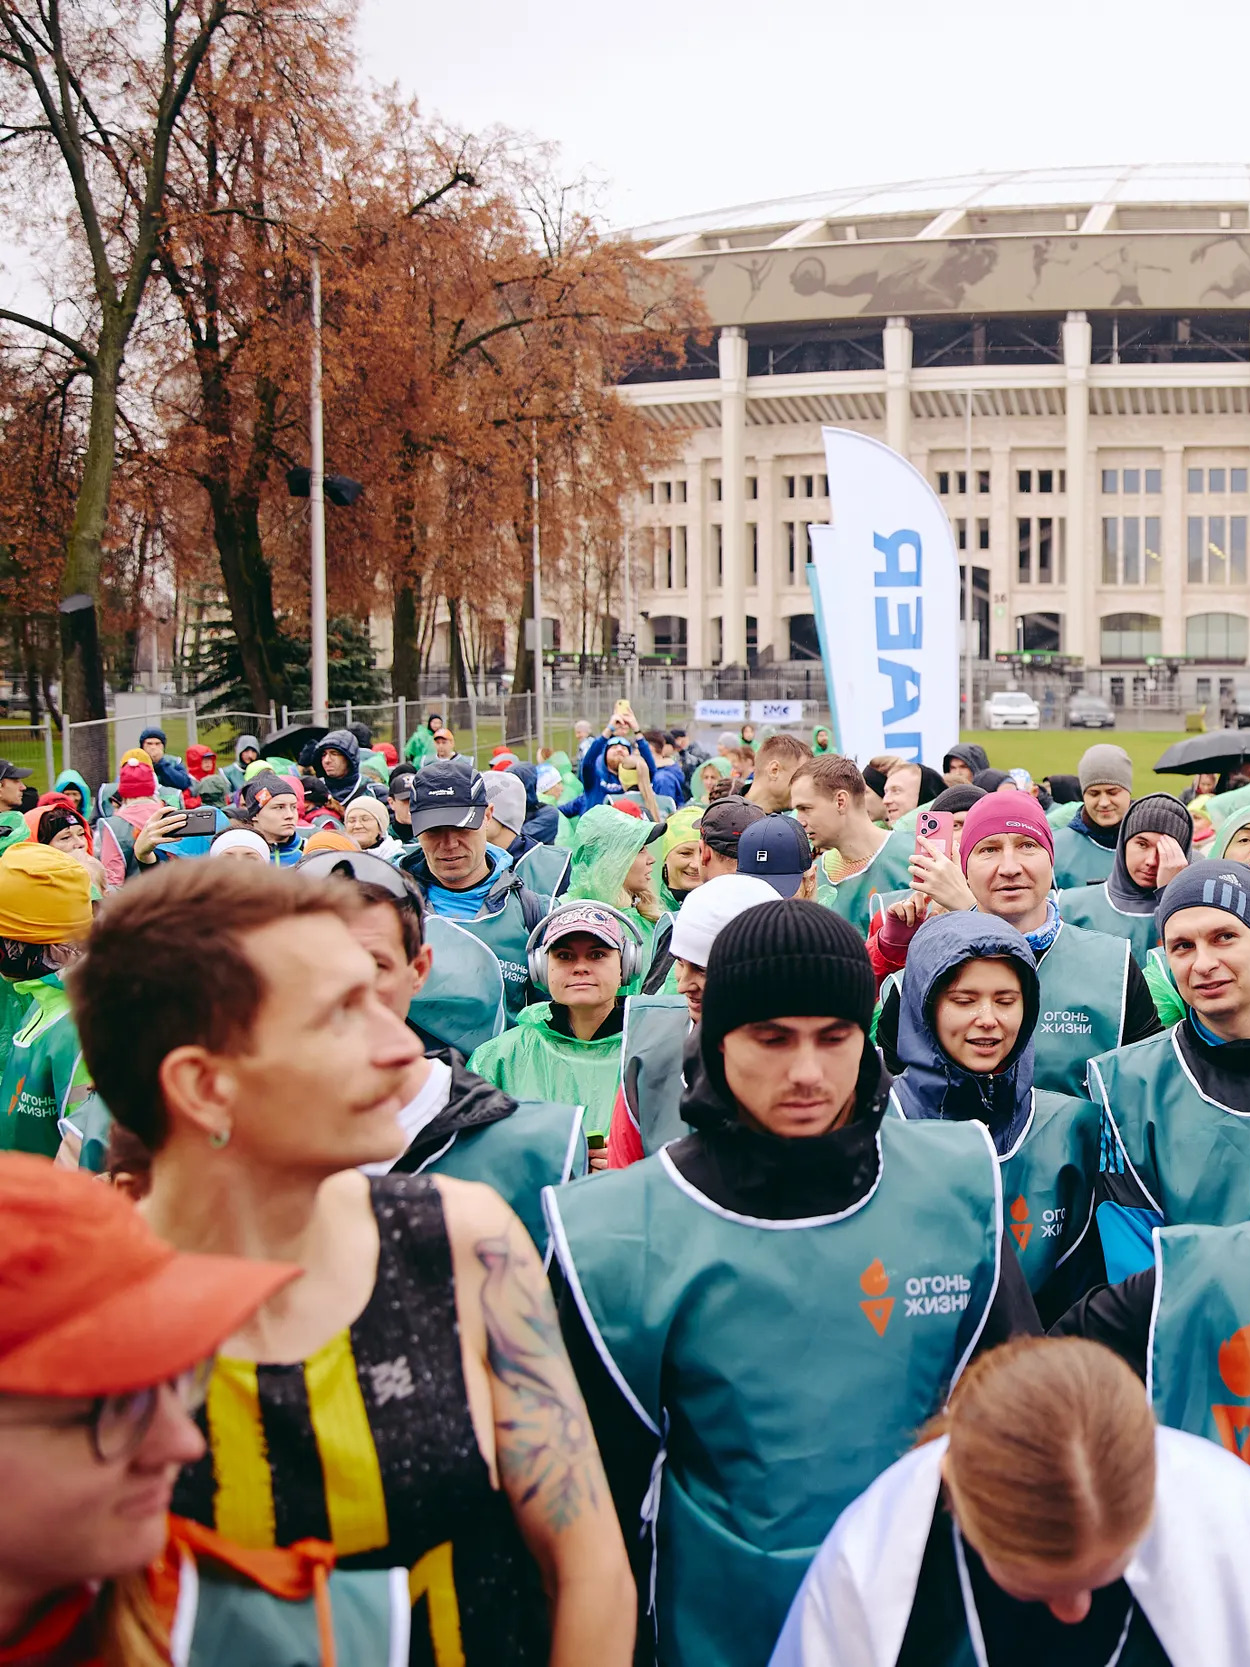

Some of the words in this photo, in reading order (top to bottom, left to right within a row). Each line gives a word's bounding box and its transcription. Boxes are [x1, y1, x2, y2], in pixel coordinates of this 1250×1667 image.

[1043, 1011, 1089, 1022] ОГОНЬ
[1040, 1023, 1092, 1034] ЖИЗНИ
[905, 1273, 971, 1296] ОГОНЬ
